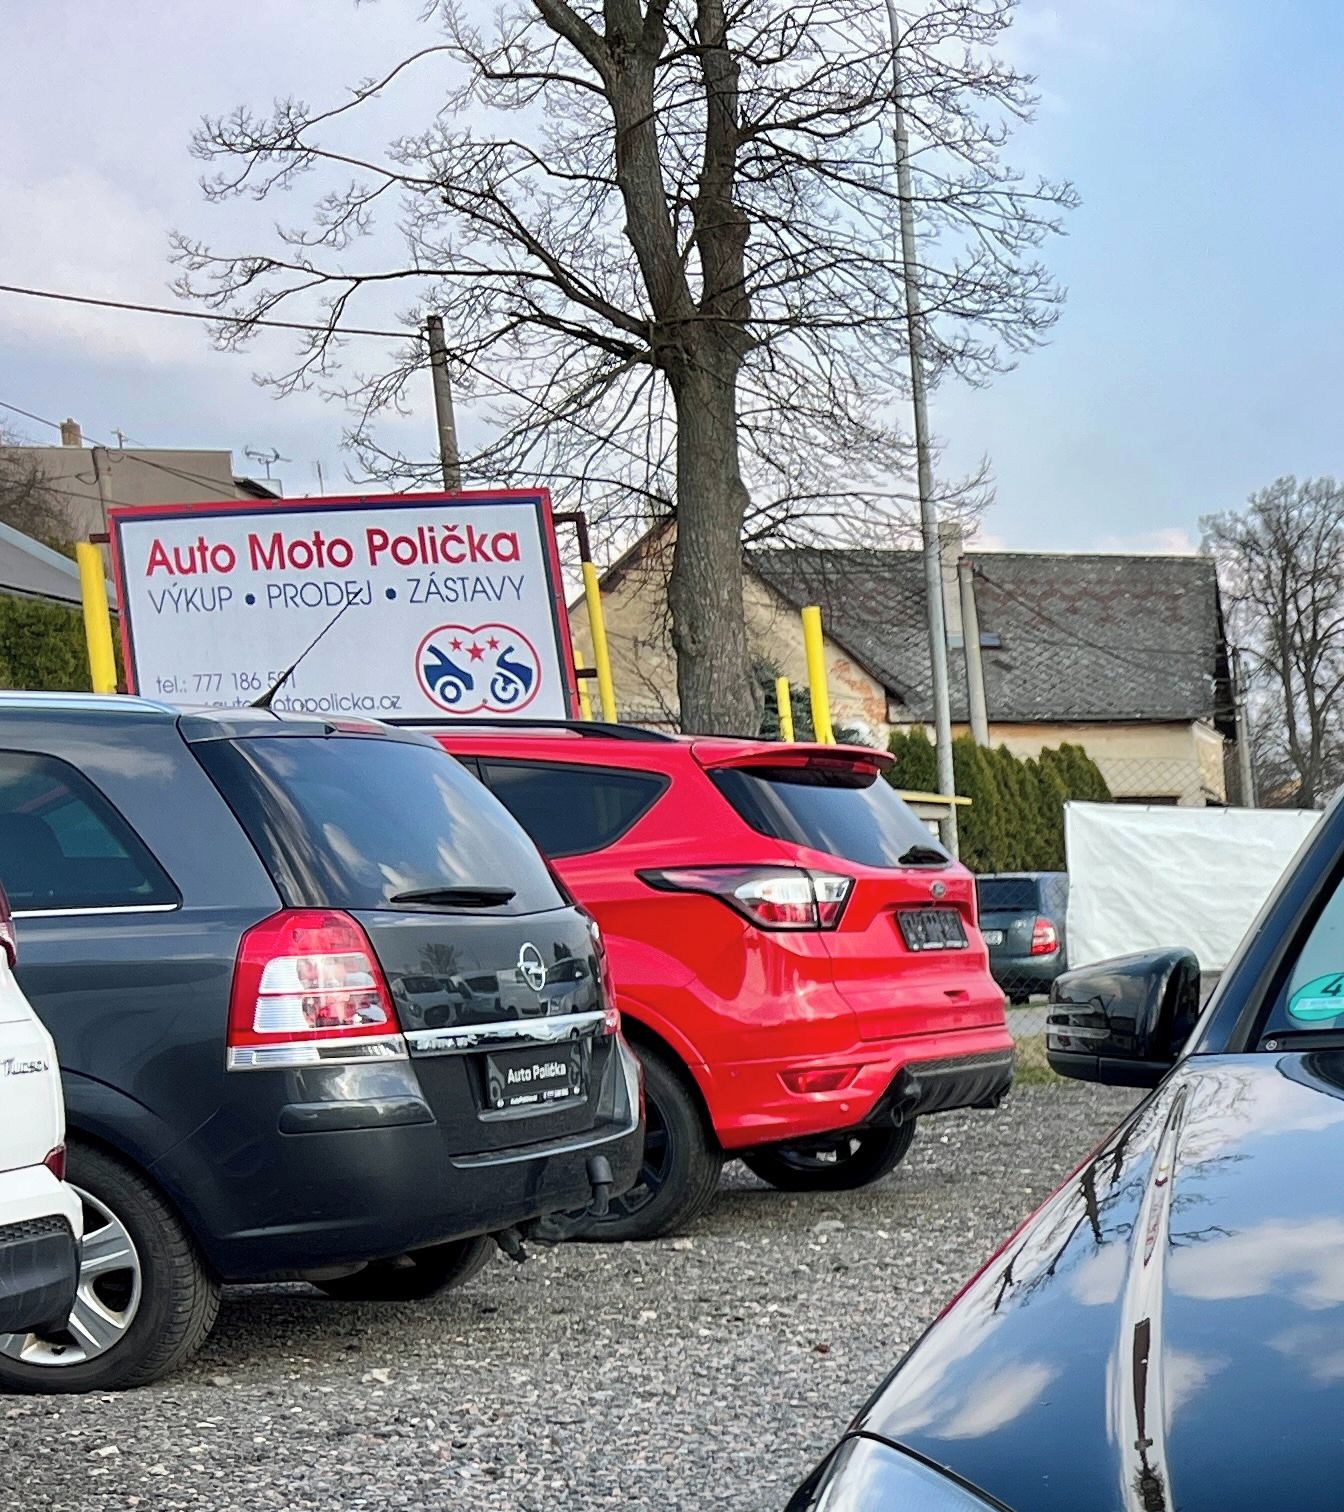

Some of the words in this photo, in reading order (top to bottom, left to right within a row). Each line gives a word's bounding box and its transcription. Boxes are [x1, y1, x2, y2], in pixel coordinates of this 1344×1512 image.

[145, 535, 236, 577] Auto
[248, 530, 353, 571] Moto
[365, 524, 521, 567] Polička
[148, 582, 233, 614] VÝKUP
[266, 580, 372, 609] PRODEJ
[406, 571, 525, 604] ZÁSTAVY
[156, 675, 188, 695] tel.:
[192, 673, 223, 693] 777
[231, 671, 262, 691] 186
[1321, 975, 1344, 996] 4
[507, 1068, 532, 1085] Auto
[532, 1061, 567, 1081] Polička
